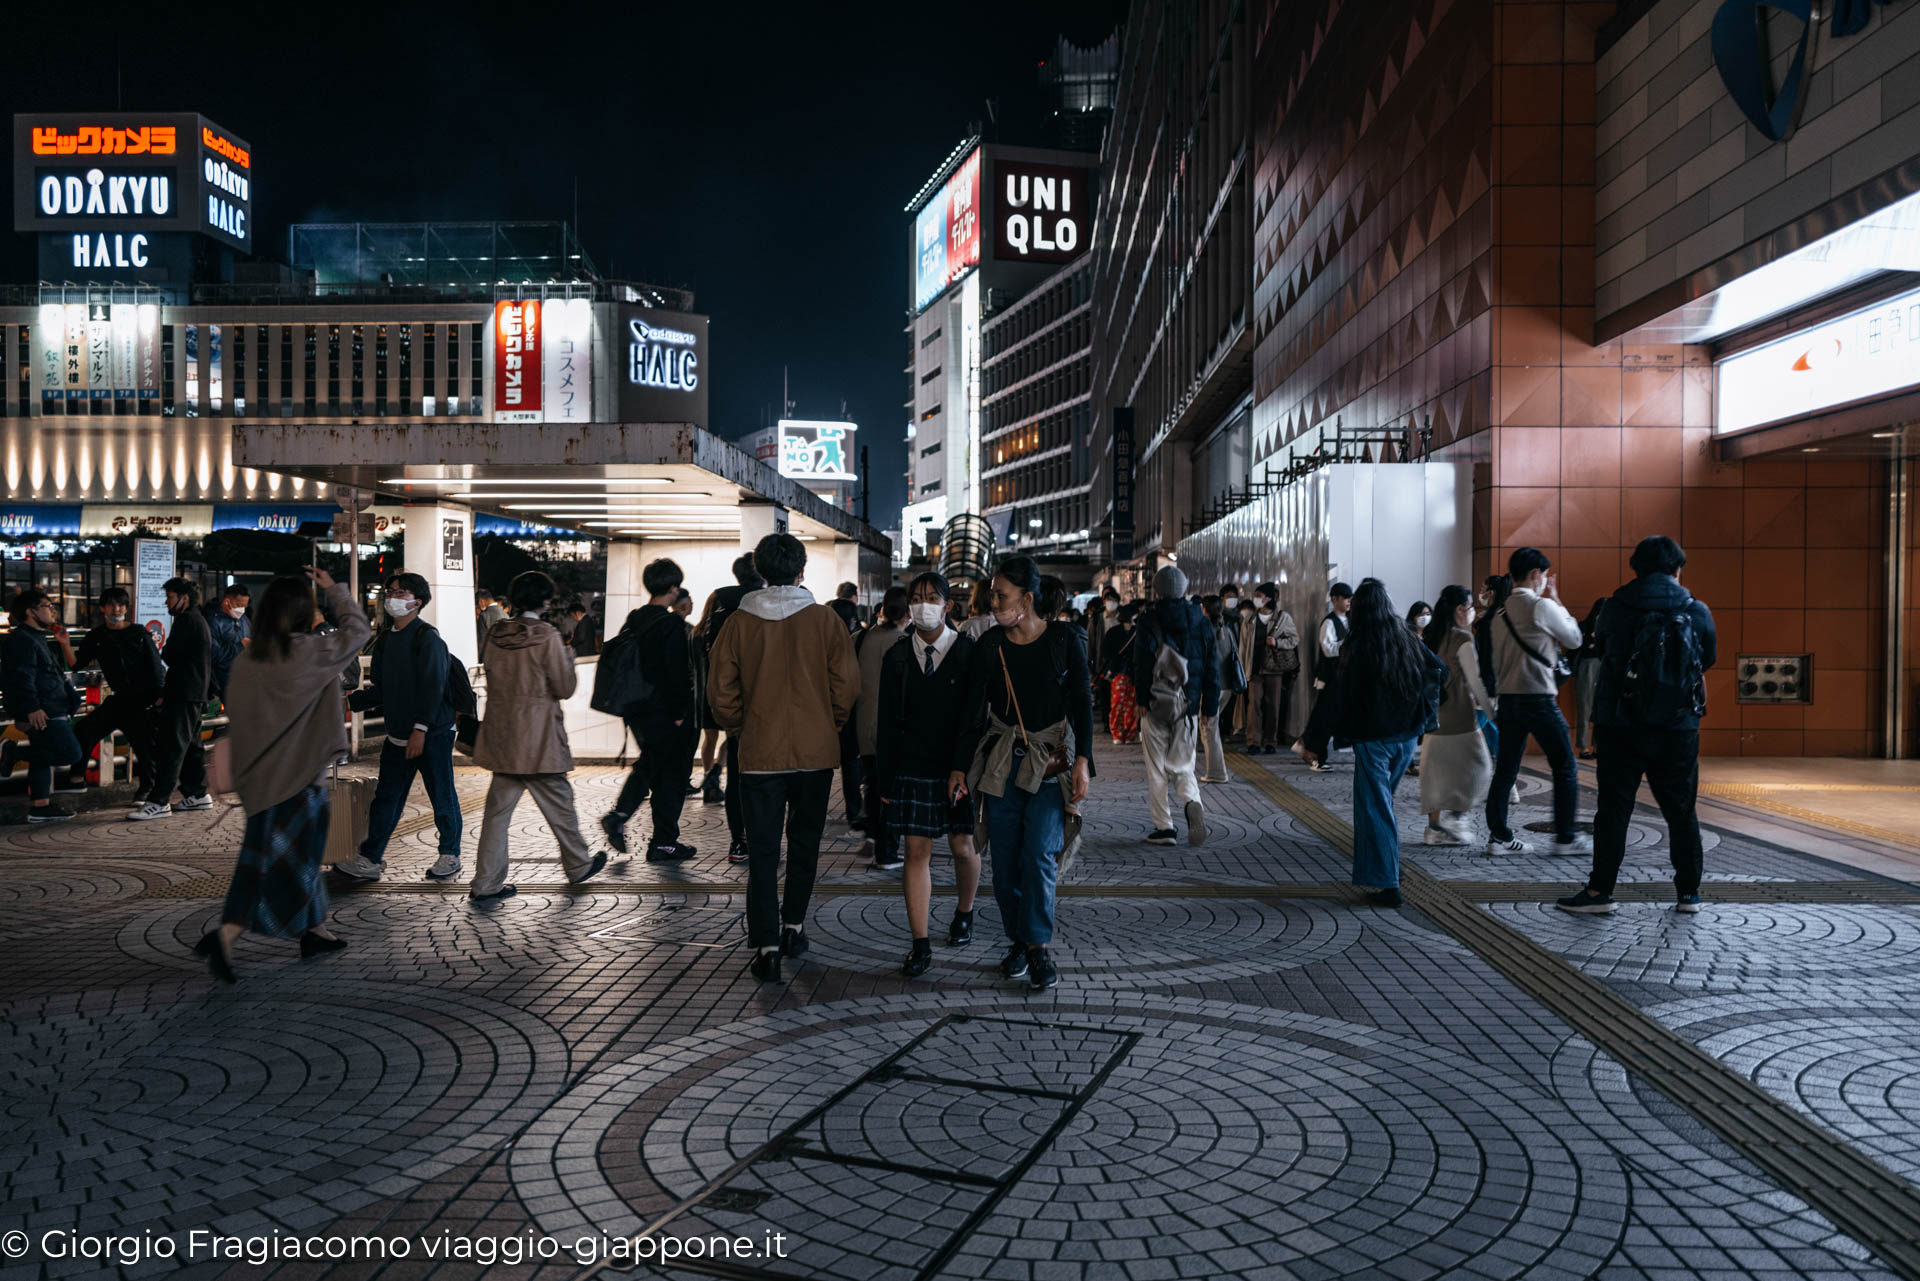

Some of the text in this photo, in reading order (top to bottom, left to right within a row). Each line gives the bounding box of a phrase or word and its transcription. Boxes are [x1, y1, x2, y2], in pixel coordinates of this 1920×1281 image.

[32, 126, 176, 155] ビックカメラ
[202, 126, 250, 169] ビックカメラ
[41, 170, 169, 215] ODAKYU
[204, 158, 248, 201] ODAKYU
[1006, 174, 1071, 212] UNI
[208, 195, 246, 239] HALC
[1006, 213, 1078, 255] QLO
[73, 232, 149, 268] HALC
[92, 327, 103, 384] サンマルク
[631, 344, 697, 390] HALC
[0, 513, 34, 529] DAKYU
[258, 514, 298, 529] ODAKYU
